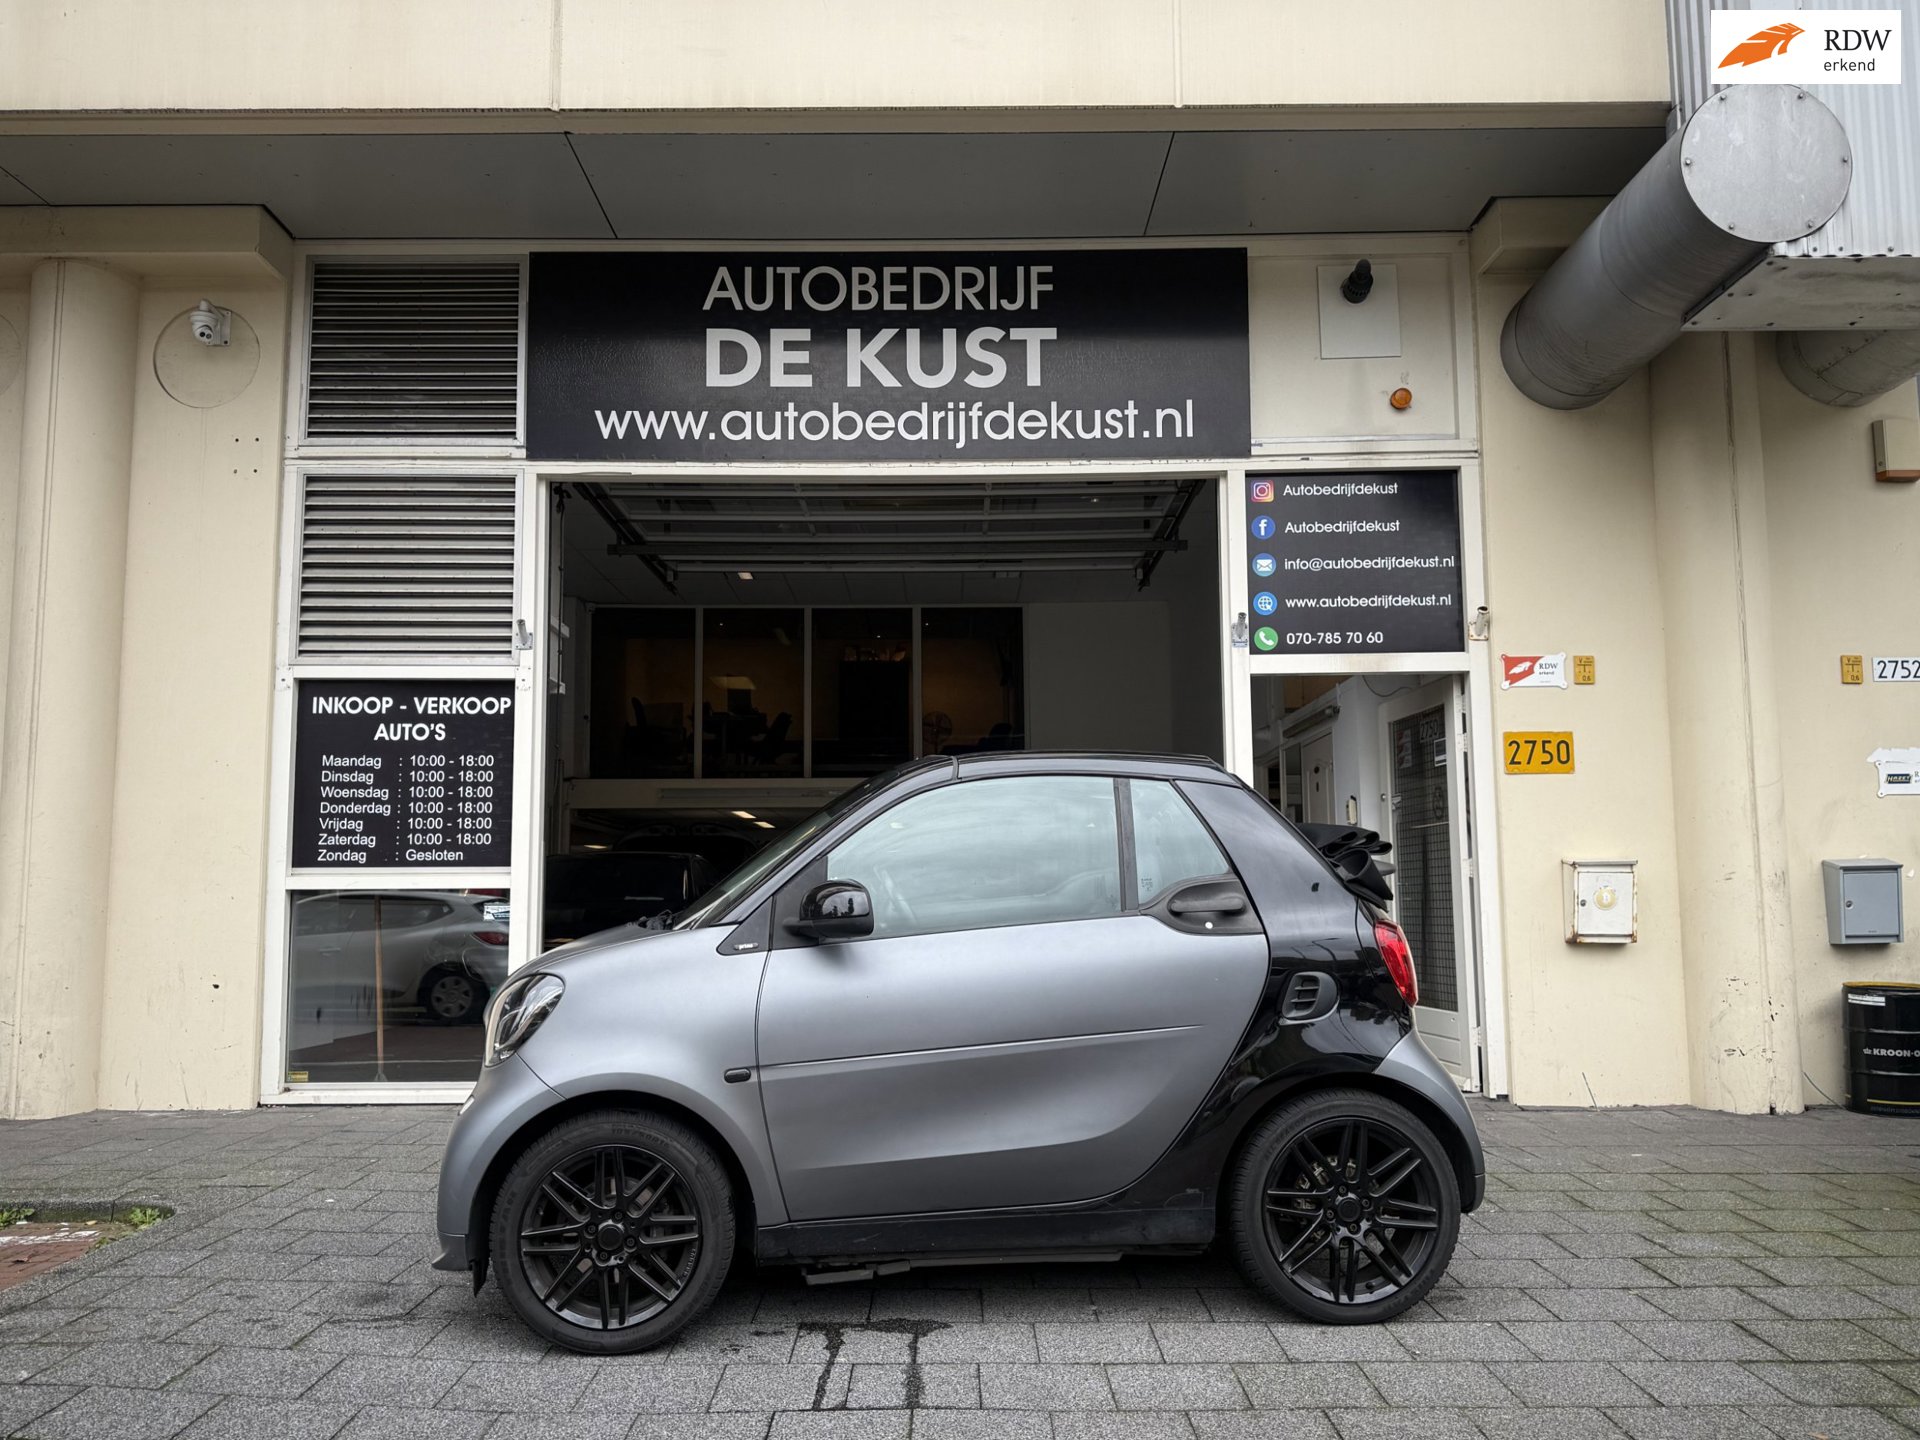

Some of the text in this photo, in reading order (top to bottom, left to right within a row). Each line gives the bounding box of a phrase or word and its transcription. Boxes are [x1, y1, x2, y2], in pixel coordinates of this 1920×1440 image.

[703, 266, 1053, 311] AUTOBEDRIJF
[706, 327, 1056, 388] DE KUST
[595, 400, 1193, 448] www.autobedrijfdekust.nl
[1283, 483, 1397, 496] Autobedrijfdekust
[1285, 520, 1399, 534] Autobedrijfdekust
[1285, 556, 1454, 571] info@autobedrijfdekust.nl
[1286, 594, 1451, 608] www.autobedrijfdekust.nl
[1287, 632, 1383, 644] 070-785 70 60
[1539, 662, 1559, 670] RDW
[1877, 660, 1920, 679] 2752
[313, 697, 393, 714] INKOOP
[414, 697, 511, 714] VERKOOP
[1507, 739, 1571, 766] 2750
[323, 755, 381, 769] Maandag
[411, 755, 445, 766] 10:00
[459, 755, 494, 766] 18:00
[322, 771, 373, 784] Dinsdag
[410, 771, 444, 782] 10:00
[459, 771, 493, 782] 18:00
[321, 786, 388, 800] Woensdag
[410, 786, 444, 797] 10:00
[458, 786, 493, 797] 18:00
[321, 802, 390, 816] Donderdag
[409, 802, 443, 813] 10:00
[458, 802, 492, 813] 18:00
[320, 818, 363, 832] Vrijdag
[408, 818, 443, 829] 10:00
[457, 818, 492, 829] 18:00
[318, 834, 375, 847] Zaterdag
[408, 833, 442, 844] 10:00
[457, 833, 491, 844] 18:00
[318, 850, 366, 863] Zondag
[406, 849, 463, 860] Gesloten
